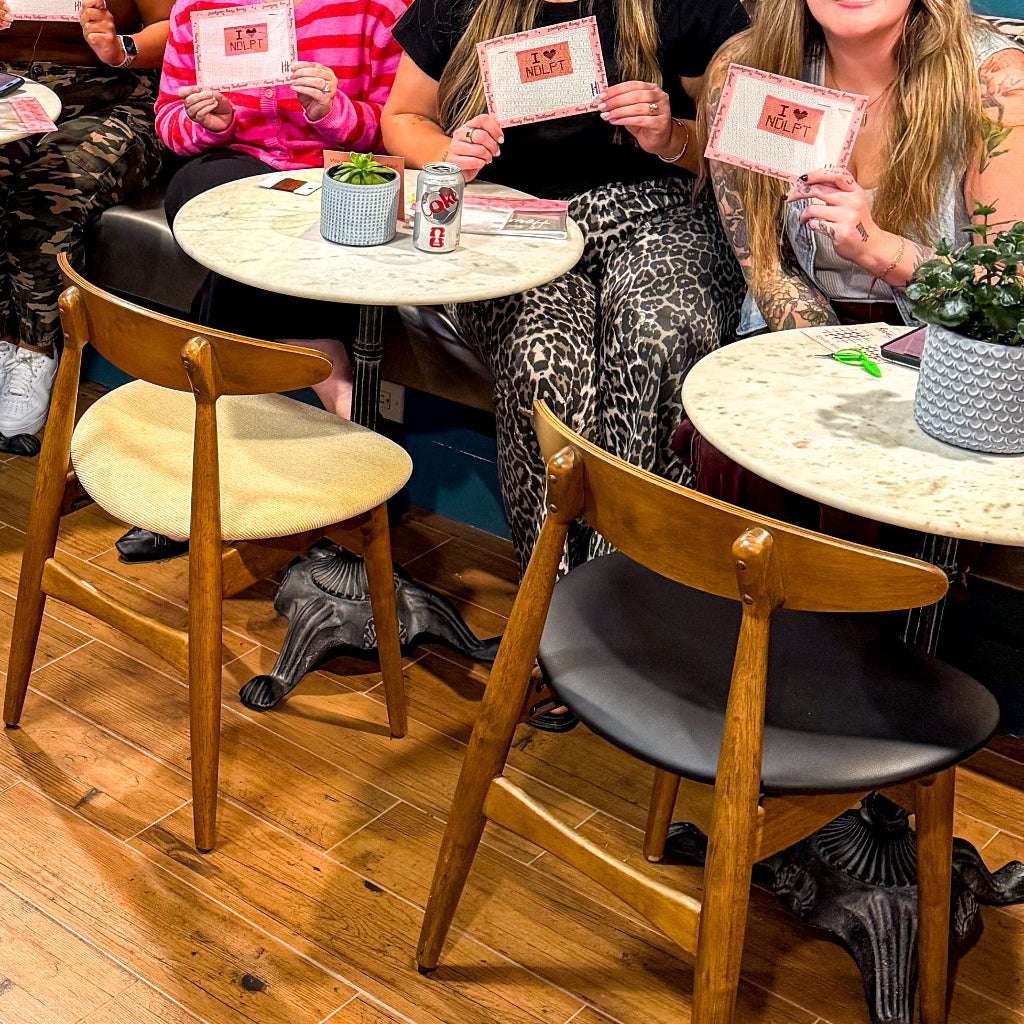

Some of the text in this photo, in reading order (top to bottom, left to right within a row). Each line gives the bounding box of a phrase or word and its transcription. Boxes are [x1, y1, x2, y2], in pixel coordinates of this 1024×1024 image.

[236, 30, 242, 40] I
[230, 38, 263, 52] NDLPT
[531, 52, 540, 64] I
[525, 59, 565, 78] NDLPT
[778, 104, 789, 117] I
[766, 115, 811, 138] NDLPT
